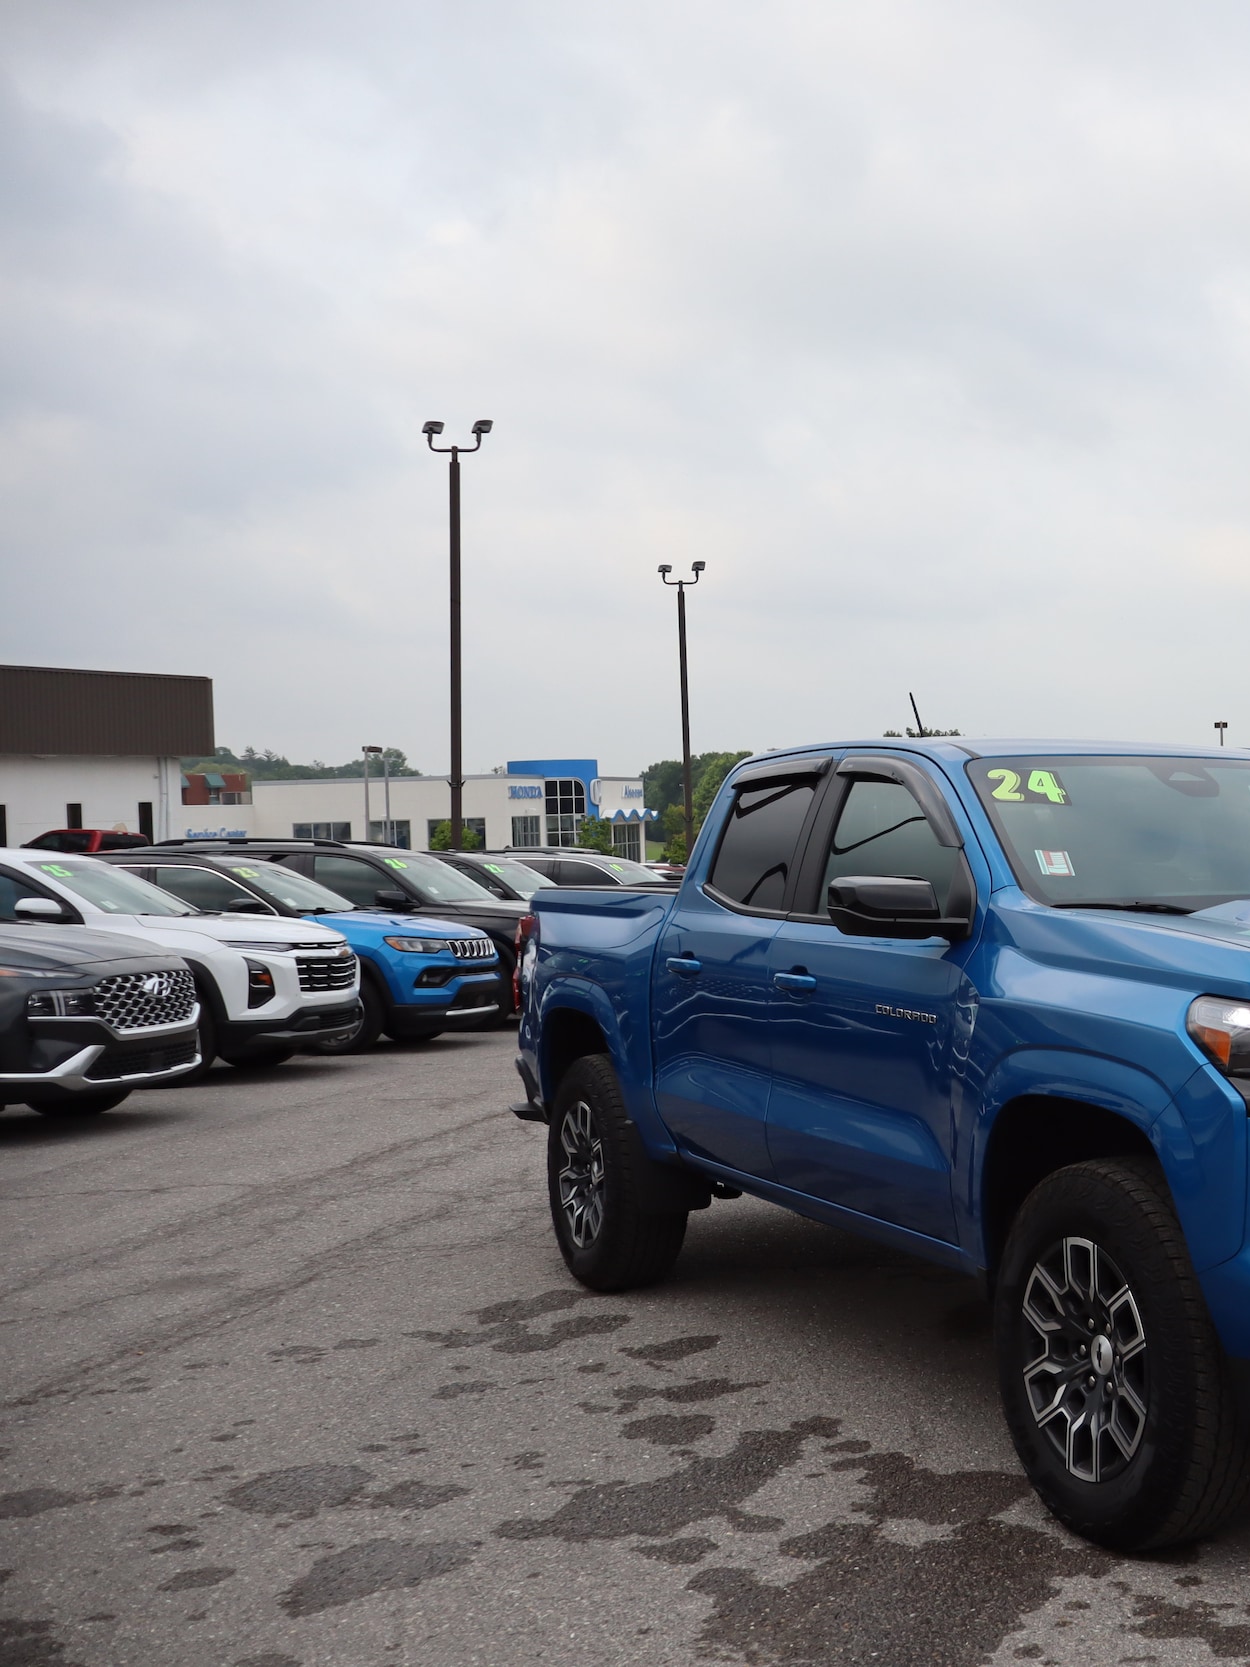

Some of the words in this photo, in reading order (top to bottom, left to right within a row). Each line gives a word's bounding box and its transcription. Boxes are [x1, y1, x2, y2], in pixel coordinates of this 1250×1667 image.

[509, 785, 543, 799] HONDA
[987, 769, 1067, 804] 24
[875, 1004, 937, 1024] COLORADO
